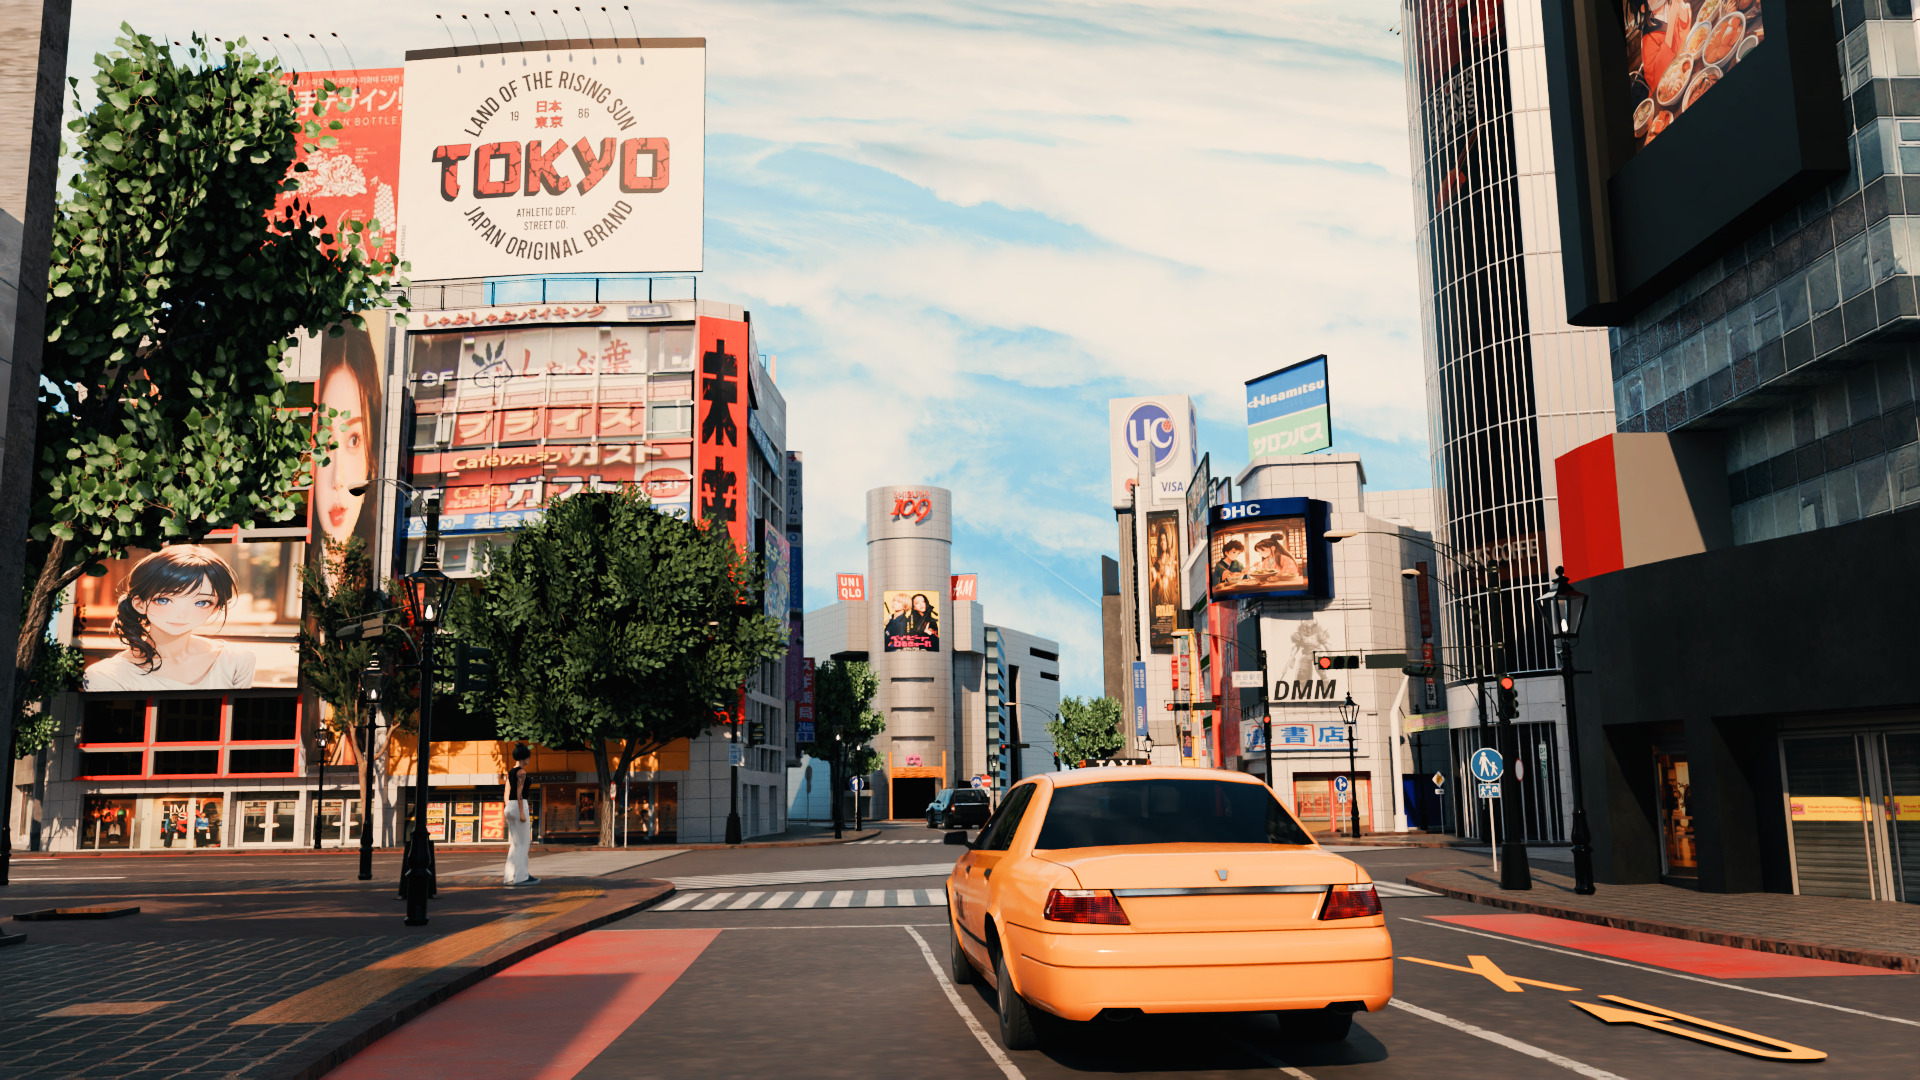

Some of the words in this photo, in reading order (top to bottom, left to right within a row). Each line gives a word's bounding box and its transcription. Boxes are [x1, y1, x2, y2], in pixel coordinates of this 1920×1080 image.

[464, 96, 500, 137] LAND
[499, 80, 518, 102] OF
[522, 71, 553, 92] THE
[558, 71, 611, 104] RISING
[607, 98, 637, 131] SUN
[536, 100, 562, 113] 日本
[354, 115, 398, 127] BOTTLE
[510, 111, 519, 122] 19
[578, 108, 590, 119] 86
[535, 115, 563, 129] 東京
[432, 136, 670, 202] TOKYO
[516, 207, 552, 218] ATHLETIC
[555, 206, 577, 216] DEPT.
[463, 206, 507, 248] JAPAN
[506, 236, 583, 261] ORIGINAL
[583, 200, 633, 248] BRAND
[524, 221, 552, 230] STREET
[555, 220, 568, 229] CO.
[424, 305, 607, 327] しゃぶしゃぶバイキング
[421, 370, 454, 388] 9F
[1247, 379, 1325, 408] Hisamitsu
[1253, 421, 1324, 456] サロンパス
[1161, 481, 1184, 492] VISA
[893, 490, 931, 499] SHIBUYA
[890, 498, 932, 524] 109
[1221, 503, 1261, 519] DHC
[841, 577, 859, 587] UNI
[841, 587, 862, 598] QLO
[1274, 679, 1337, 700] DMM
[1096, 759, 1136, 768] TAXI
[484, 803, 503, 838] SALE
